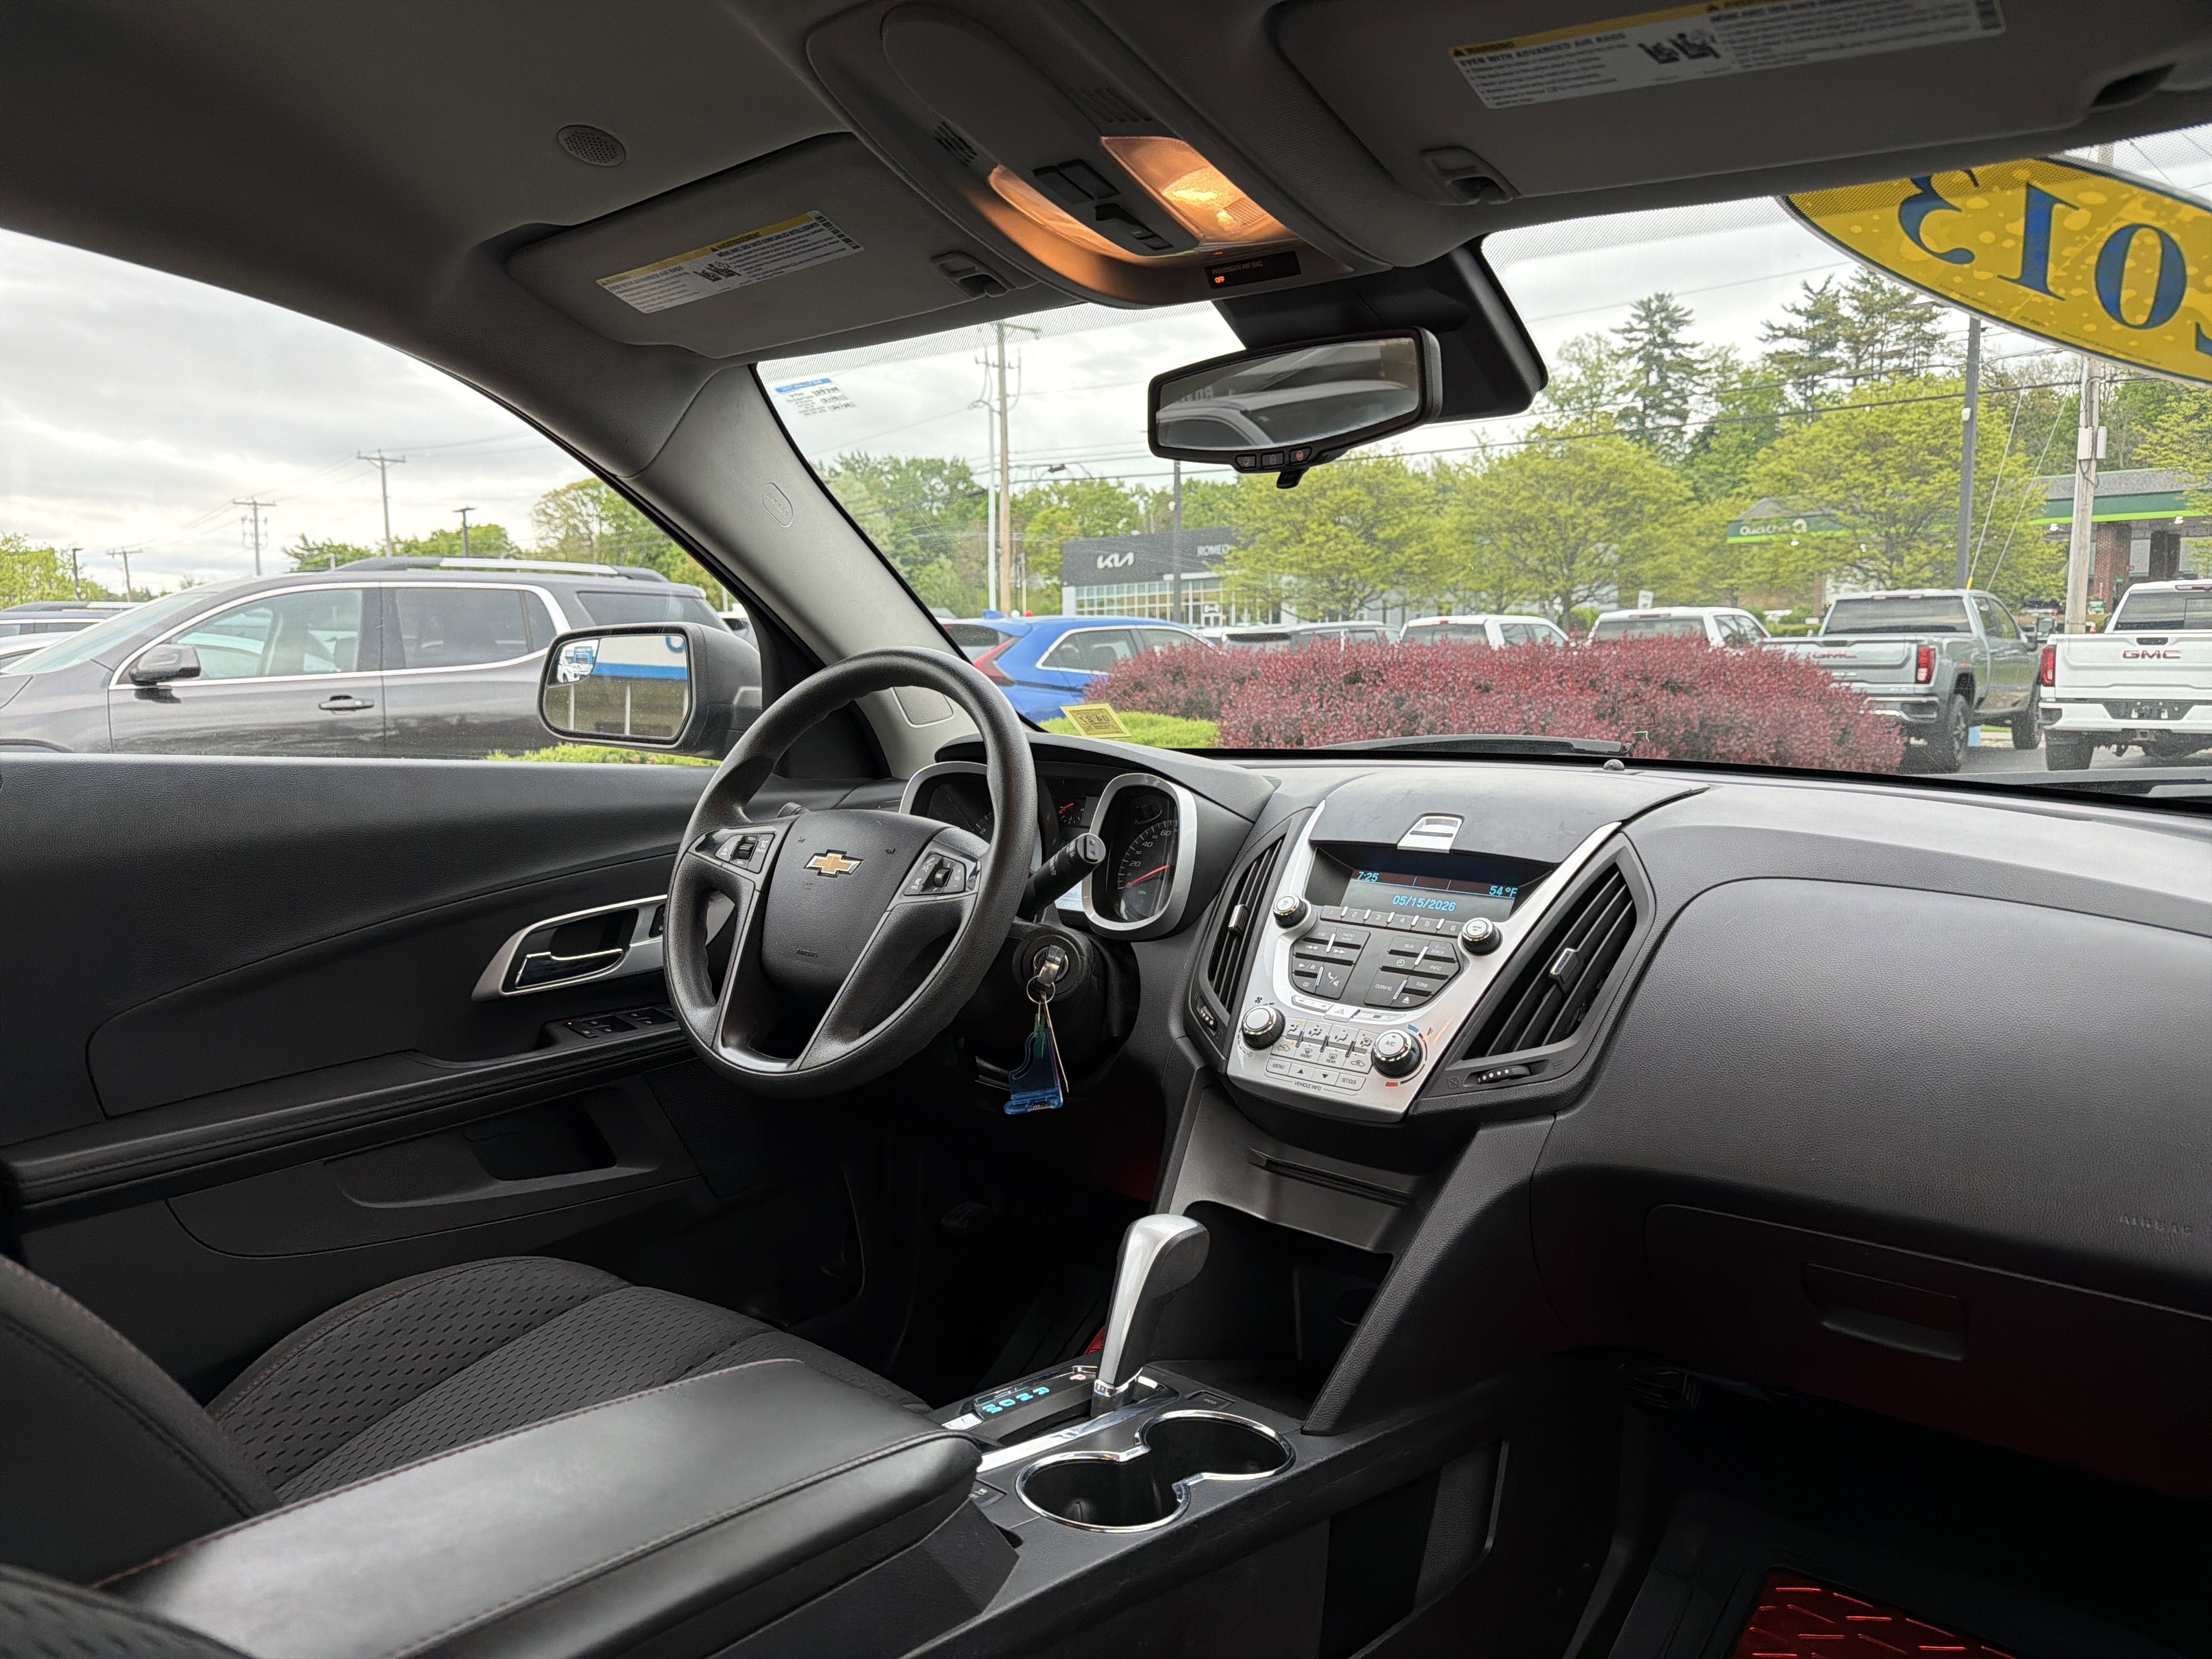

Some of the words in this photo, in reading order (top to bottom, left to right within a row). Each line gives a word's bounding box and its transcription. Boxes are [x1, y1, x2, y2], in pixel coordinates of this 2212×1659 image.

[1198, 544, 1231, 557] ROMEO
[1097, 552, 1135, 569] KIA
[2123, 650, 2181, 659] GMC
[1357, 871, 1380, 882] 7:25
[1392, 895, 1457, 911] 05/15/2026
[1294, 1080, 1312, 1089] VEHICLE
